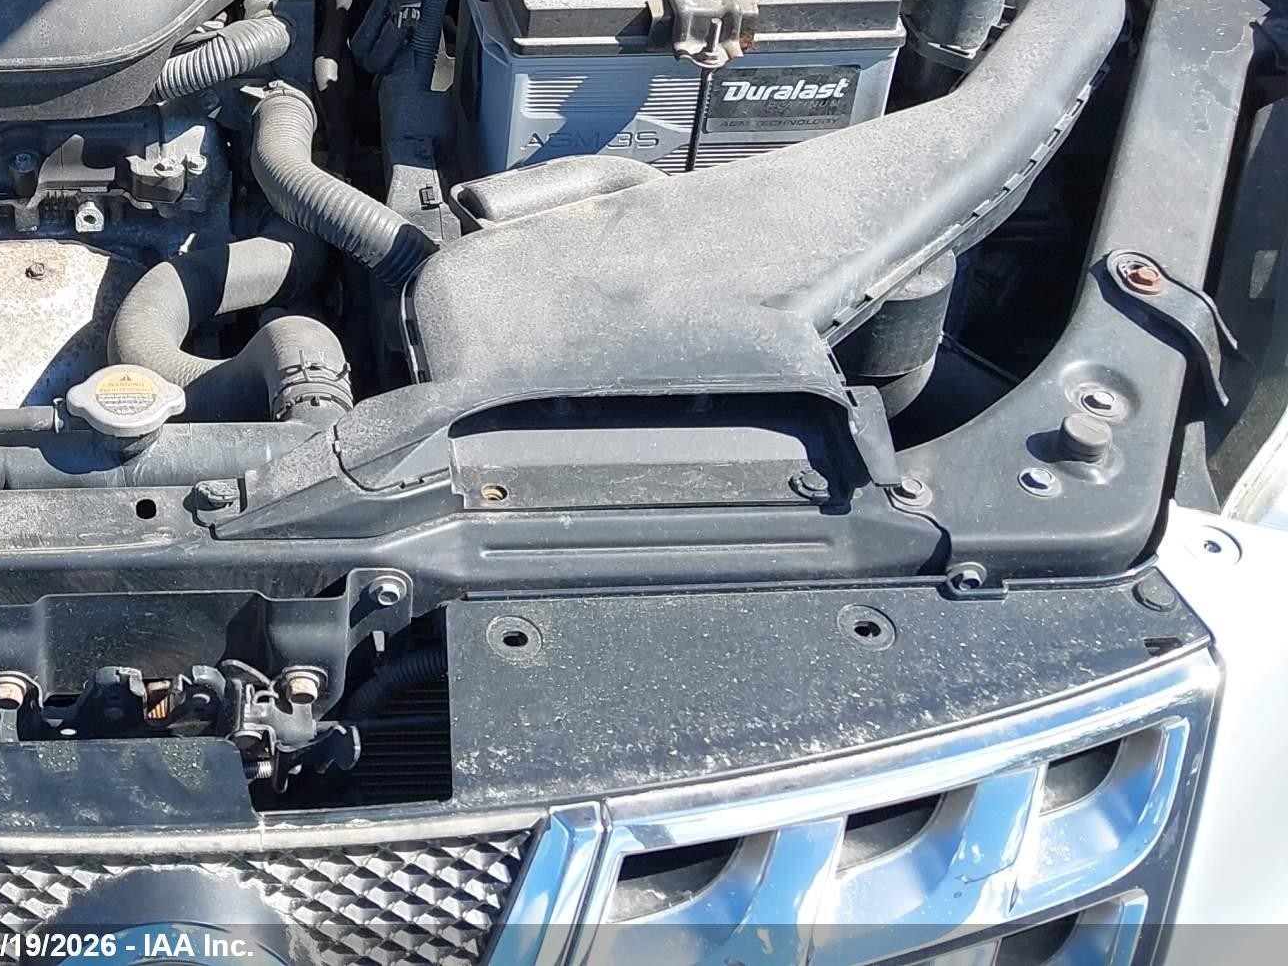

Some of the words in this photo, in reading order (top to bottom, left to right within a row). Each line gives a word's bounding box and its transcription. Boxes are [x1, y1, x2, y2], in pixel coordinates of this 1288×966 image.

[721, 78, 849, 102] Duralast
[756, 118, 840, 128] TECHNOLOGY
[520, 132, 600, 150] AGM
